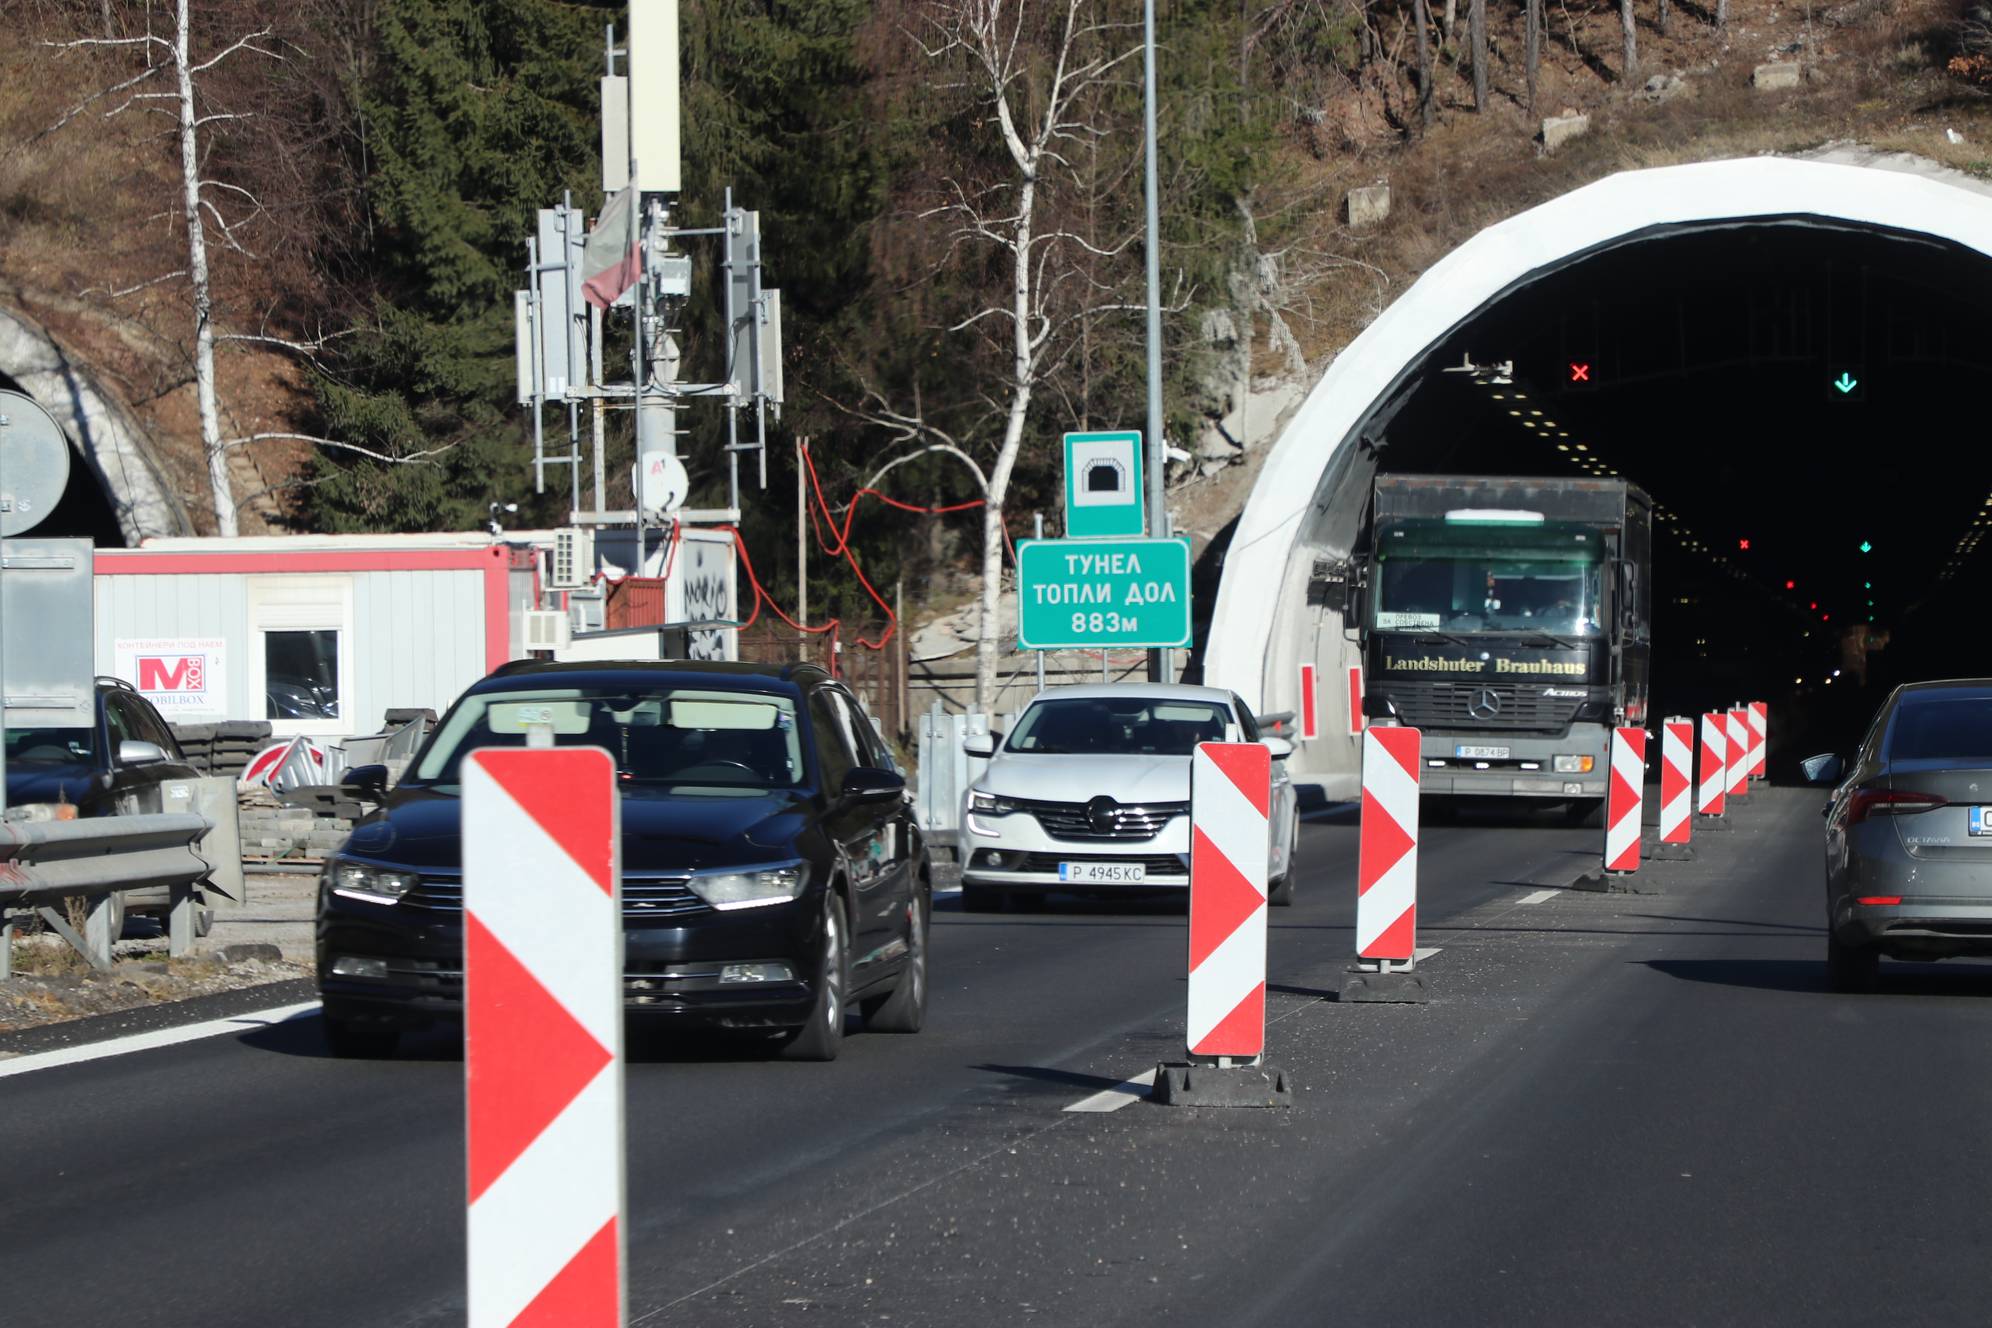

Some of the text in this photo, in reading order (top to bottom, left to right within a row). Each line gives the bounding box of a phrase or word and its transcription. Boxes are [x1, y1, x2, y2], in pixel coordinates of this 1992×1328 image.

[1065, 553, 1142, 576] ТУНЕЛ
[1032, 582, 1176, 606] ТОПЛИ ДОЛ
[1071, 612, 1138, 633] 883м
[117, 641, 176, 649] КОНТЕЙНЕРИ
[187, 657, 201, 689] BOX
[1385, 655, 1586, 675] Landshuter Brauhaus
[147, 695, 205, 705] OBILBOX
